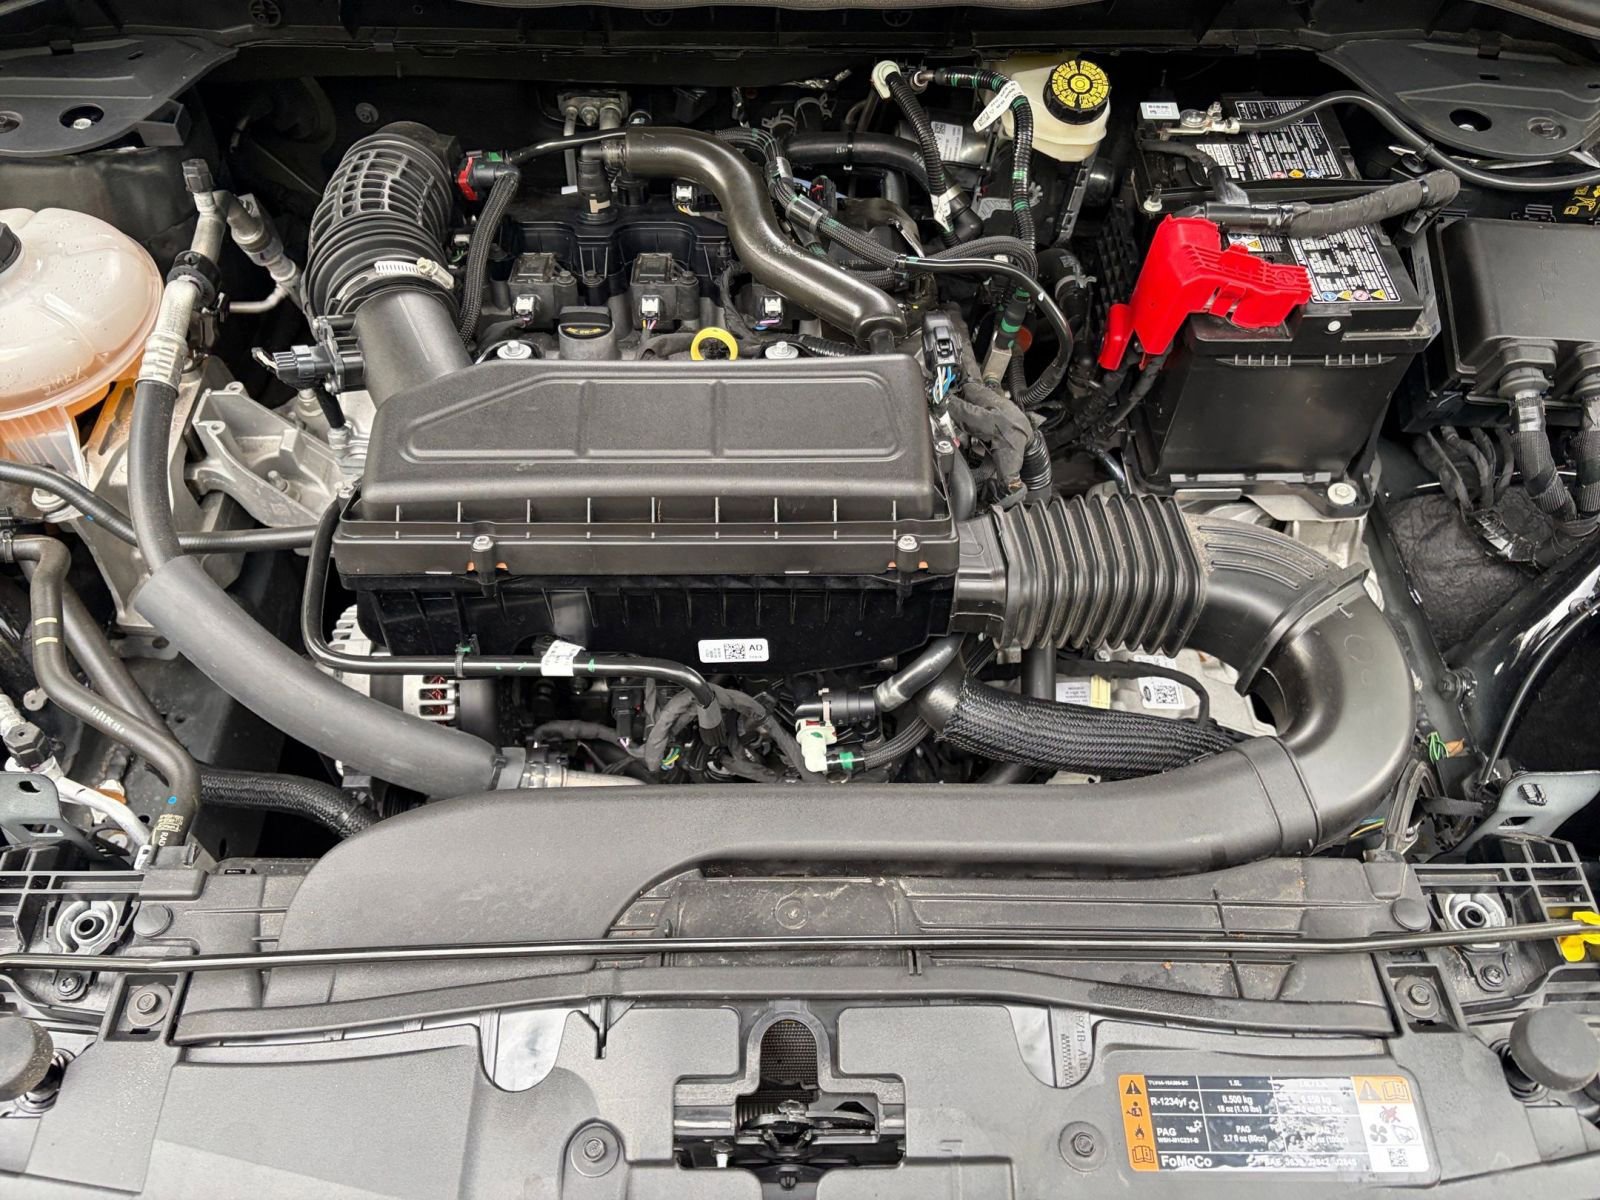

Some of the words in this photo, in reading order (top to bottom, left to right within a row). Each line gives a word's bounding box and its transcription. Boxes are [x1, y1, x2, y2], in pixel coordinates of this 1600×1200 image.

[749, 643, 763, 652] AD
[158, 832, 168, 847] RAD
[1151, 1097, 1187, 1108] R-1234yf
[1222, 1095, 1242, 1104] 0.500
[1242, 1095, 1253, 1106] kg
[1156, 1127, 1177, 1137] PAG
[1235, 1125, 1252, 1134] PAG
[1223, 1134, 1233, 1142] 2.7
[1161, 1155, 1213, 1168] FoMoCo
